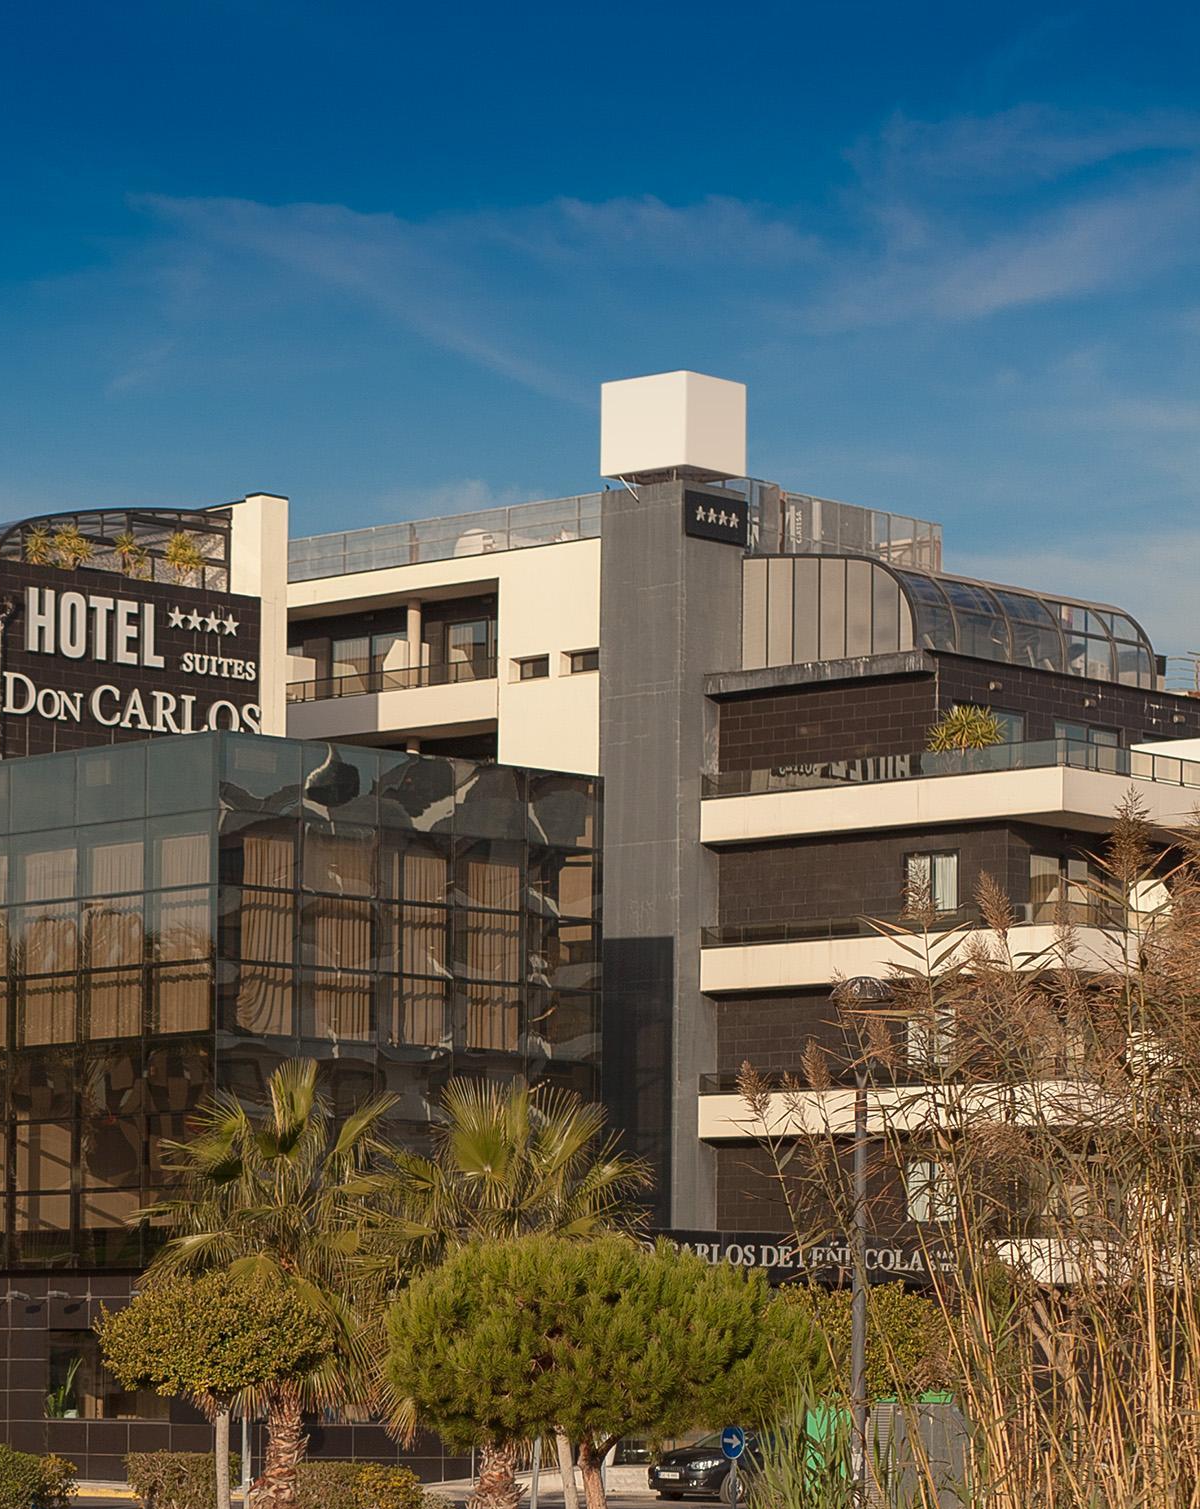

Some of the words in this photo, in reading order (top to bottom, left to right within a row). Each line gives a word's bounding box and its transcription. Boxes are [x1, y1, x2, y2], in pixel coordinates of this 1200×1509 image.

[24, 586, 165, 668] HOTEL
[181, 652, 257, 681] SUITES
[2, 671, 84, 723] DON
[90, 684, 262, 734] CARLOS
[760, 1245, 793, 1268] DE
